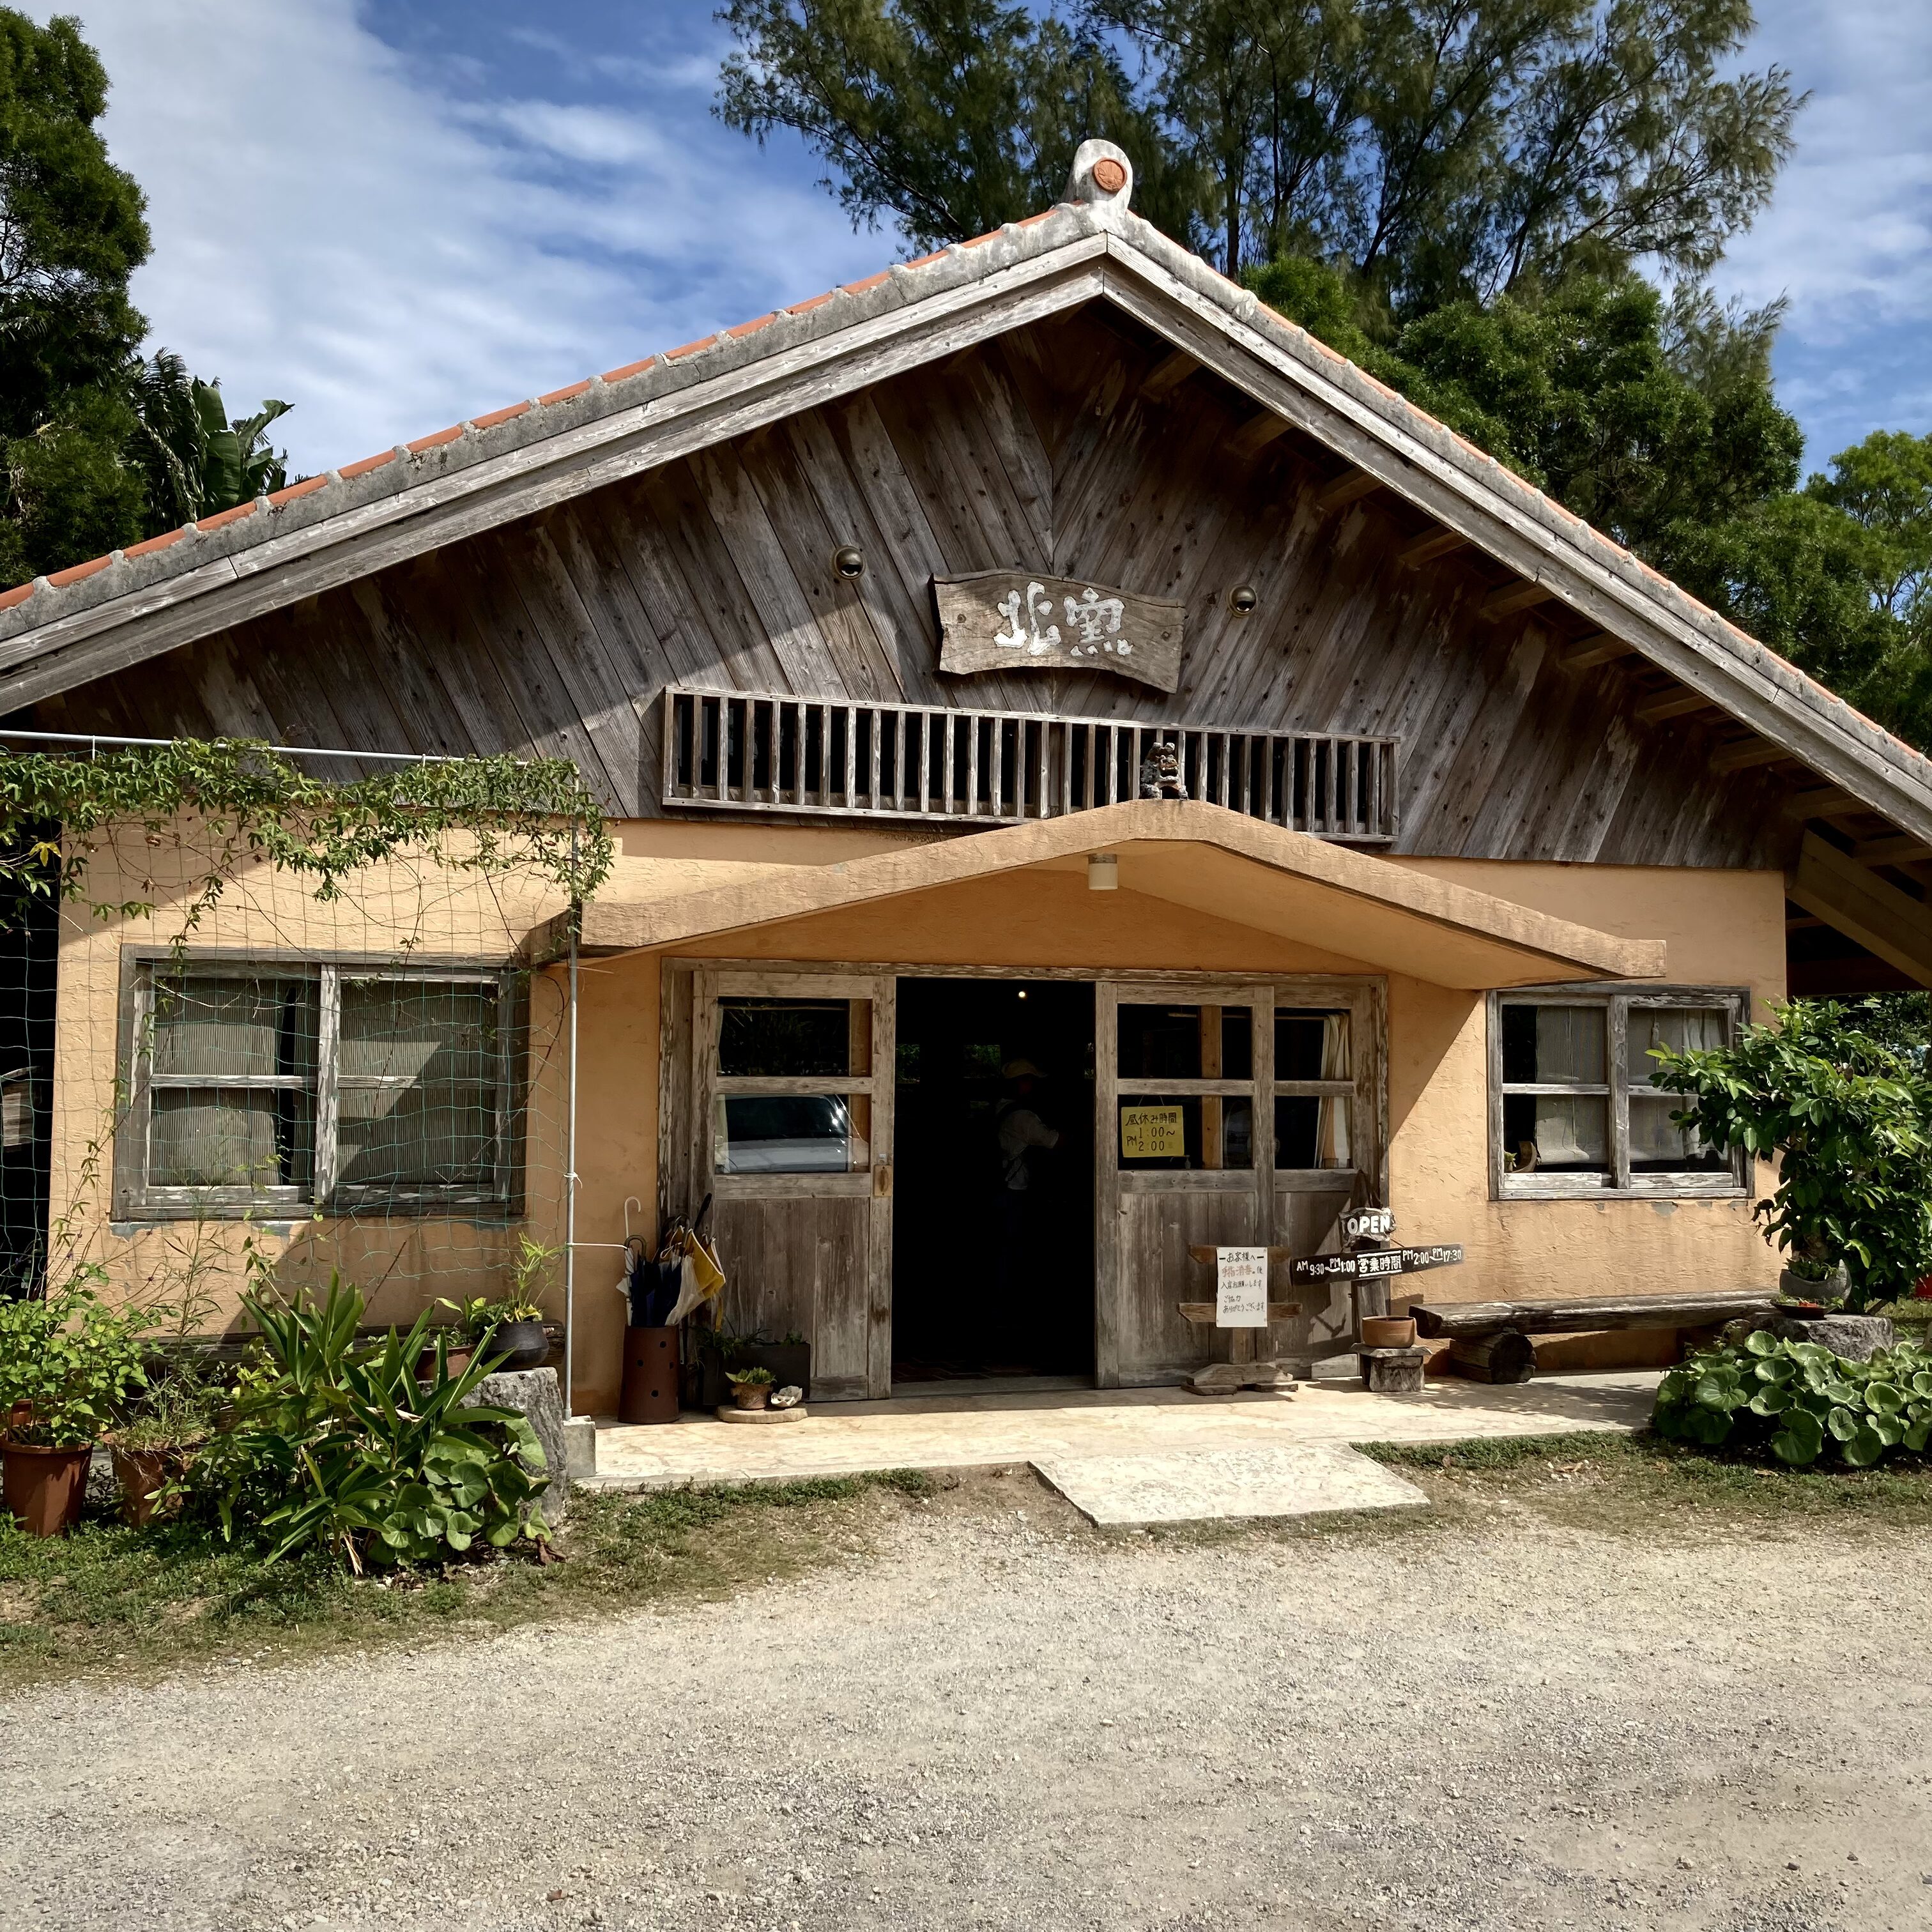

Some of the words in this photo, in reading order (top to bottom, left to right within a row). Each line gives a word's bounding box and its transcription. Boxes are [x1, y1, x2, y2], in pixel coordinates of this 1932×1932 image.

[993, 581, 1133, 657] 北窯
[1125, 1112, 1177, 1126] 昼休み時間
[1126, 1136, 1137, 1147] PM
[1347, 1215, 1390, 1235] OPEN
[1357, 1255, 1402, 1273] 営業時間
